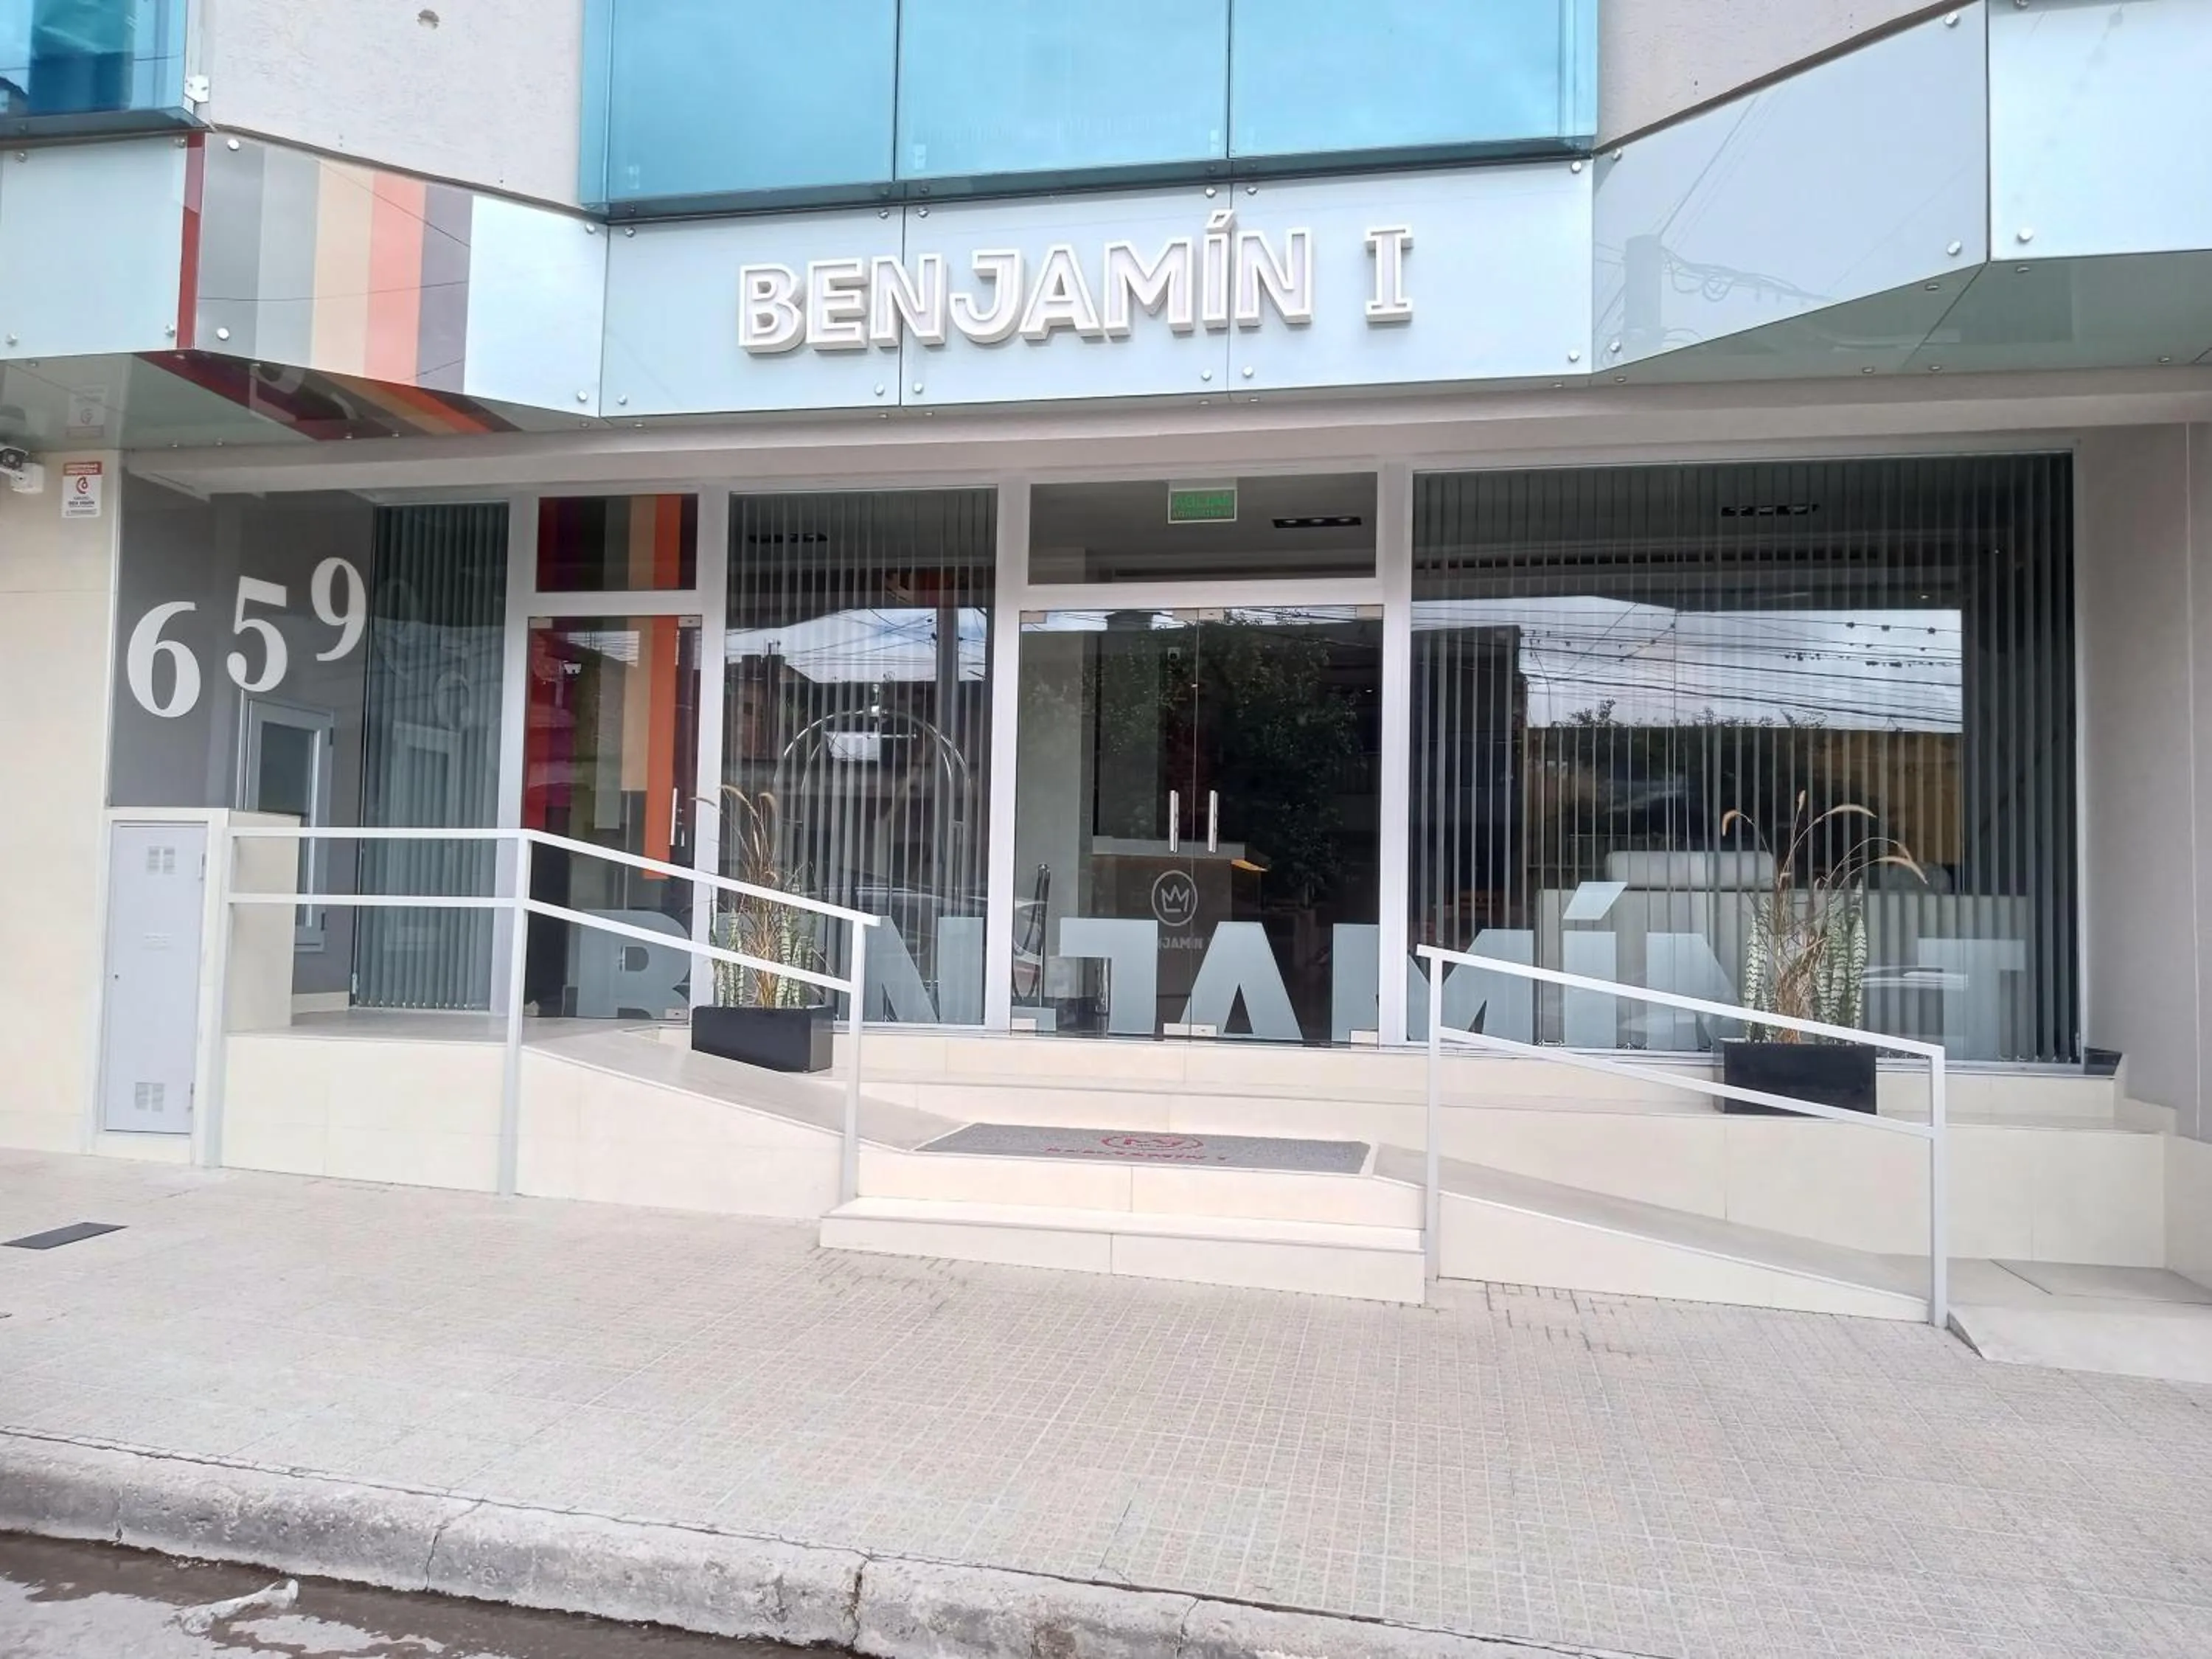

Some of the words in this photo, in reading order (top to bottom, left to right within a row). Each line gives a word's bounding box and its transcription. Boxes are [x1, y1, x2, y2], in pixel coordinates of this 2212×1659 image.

[738, 209, 1313, 353] BENJAMÍN
[1365, 224, 1413, 323] I
[128, 557, 366, 717] 659
